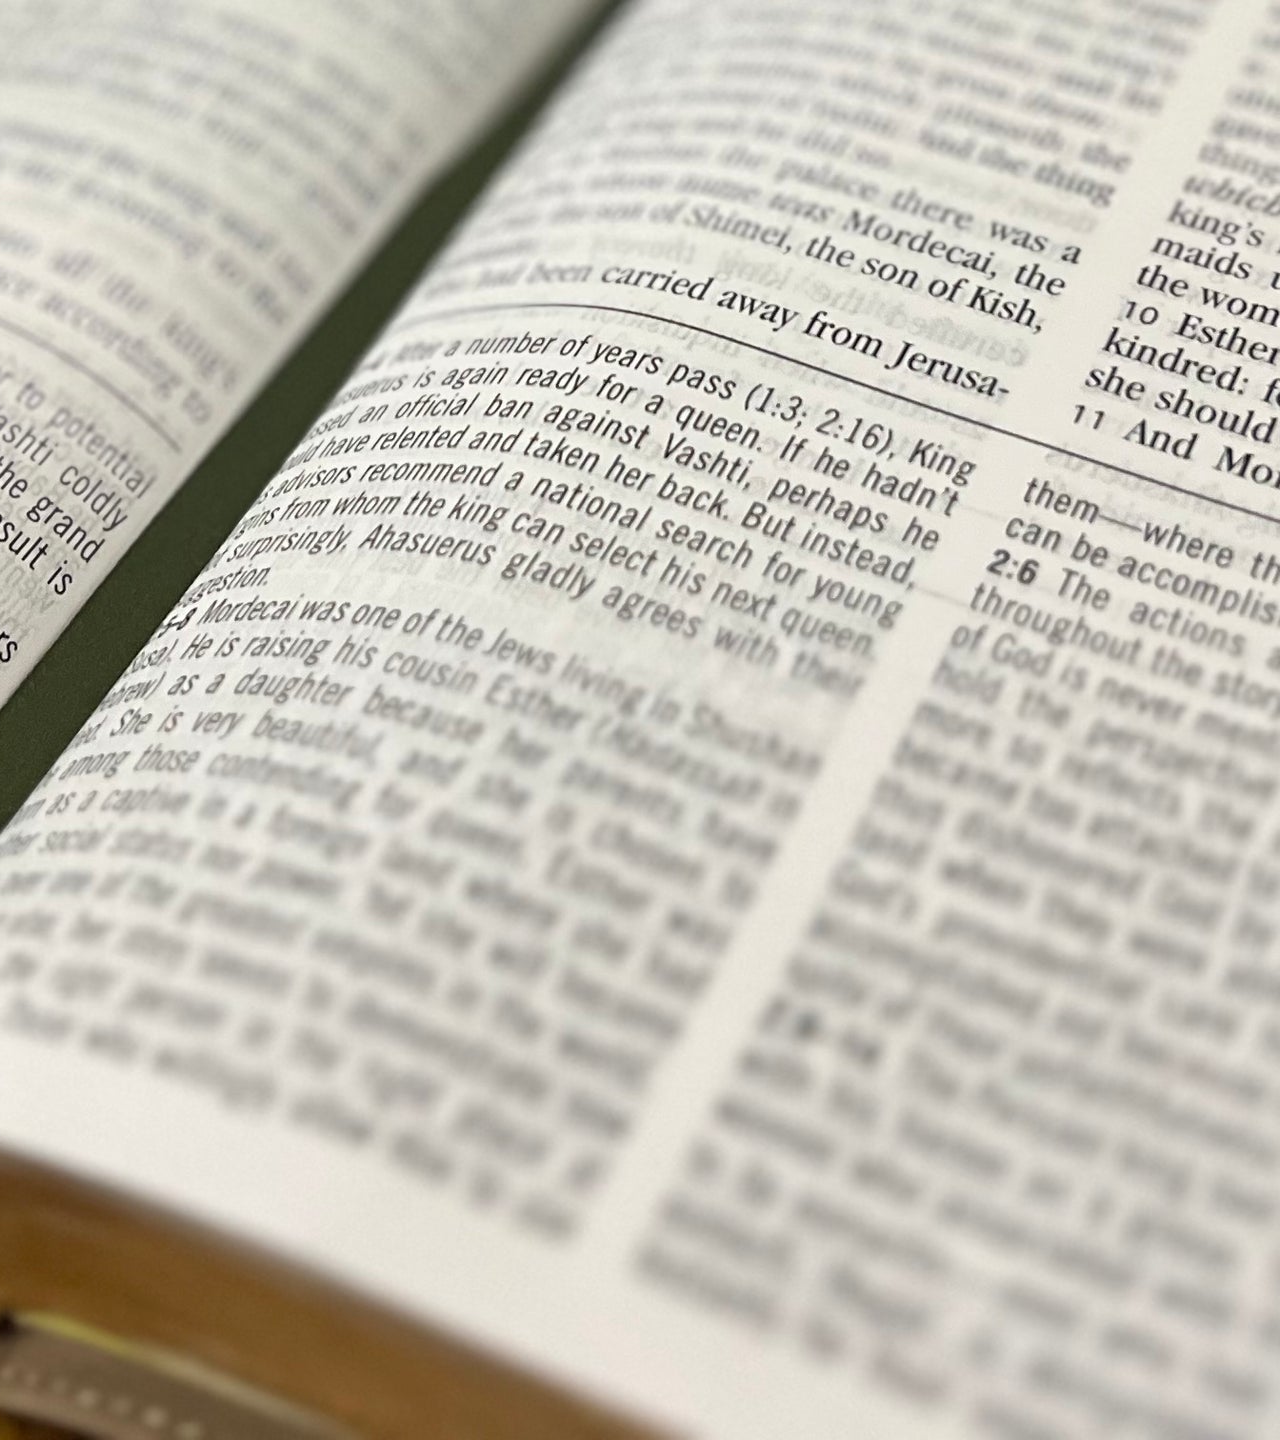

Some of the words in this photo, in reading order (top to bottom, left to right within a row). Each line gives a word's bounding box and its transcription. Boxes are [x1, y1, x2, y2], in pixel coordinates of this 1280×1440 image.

[1014, 263, 1066, 296] the
[1136, 264, 1190, 298] the
[1151, 237, 1253, 280] maids
[860, 258, 919, 290] son
[927, 278, 970, 303] of
[966, 285, 1042, 334] Kish,
[1125, 300, 1160, 326] 10
[601, 267, 715, 301] carried
[716, 291, 800, 333] away
[802, 310, 884, 359] from
[883, 341, 1010, 398] Jerusa-
[1102, 326, 1249, 396] kindred:
[515, 366, 590, 397] ready
[595, 373, 639, 405] for
[675, 404, 762, 452] queen.
[559, 334, 593, 358] of
[586, 342, 665, 375] years
[665, 363, 737, 400] pass
[744, 383, 807, 429] (1:3;
[1084, 365, 1146, 402] she
[1153, 388, 1278, 445] should
[467, 428, 524, 453] and
[523, 431, 601, 474] taken
[604, 454, 656, 492] her
[483, 392, 534, 420] ban
[543, 405, 650, 451] against
[663, 432, 753, 491] Vashti,
[1073, 404, 1105, 430] 11
[1123, 419, 1199, 461] And
[25, 495, 106, 564] grand
[59, 465, 128, 533] coldly
[272, 465, 358, 498] advisors
[359, 462, 504, 487] recommend
[530, 477, 653, 532] national
[986, 549, 1040, 586] 2:6
[1005, 517, 1062, 552] can
[1070, 533, 1109, 567] be
[46, 565, 73, 596] is
